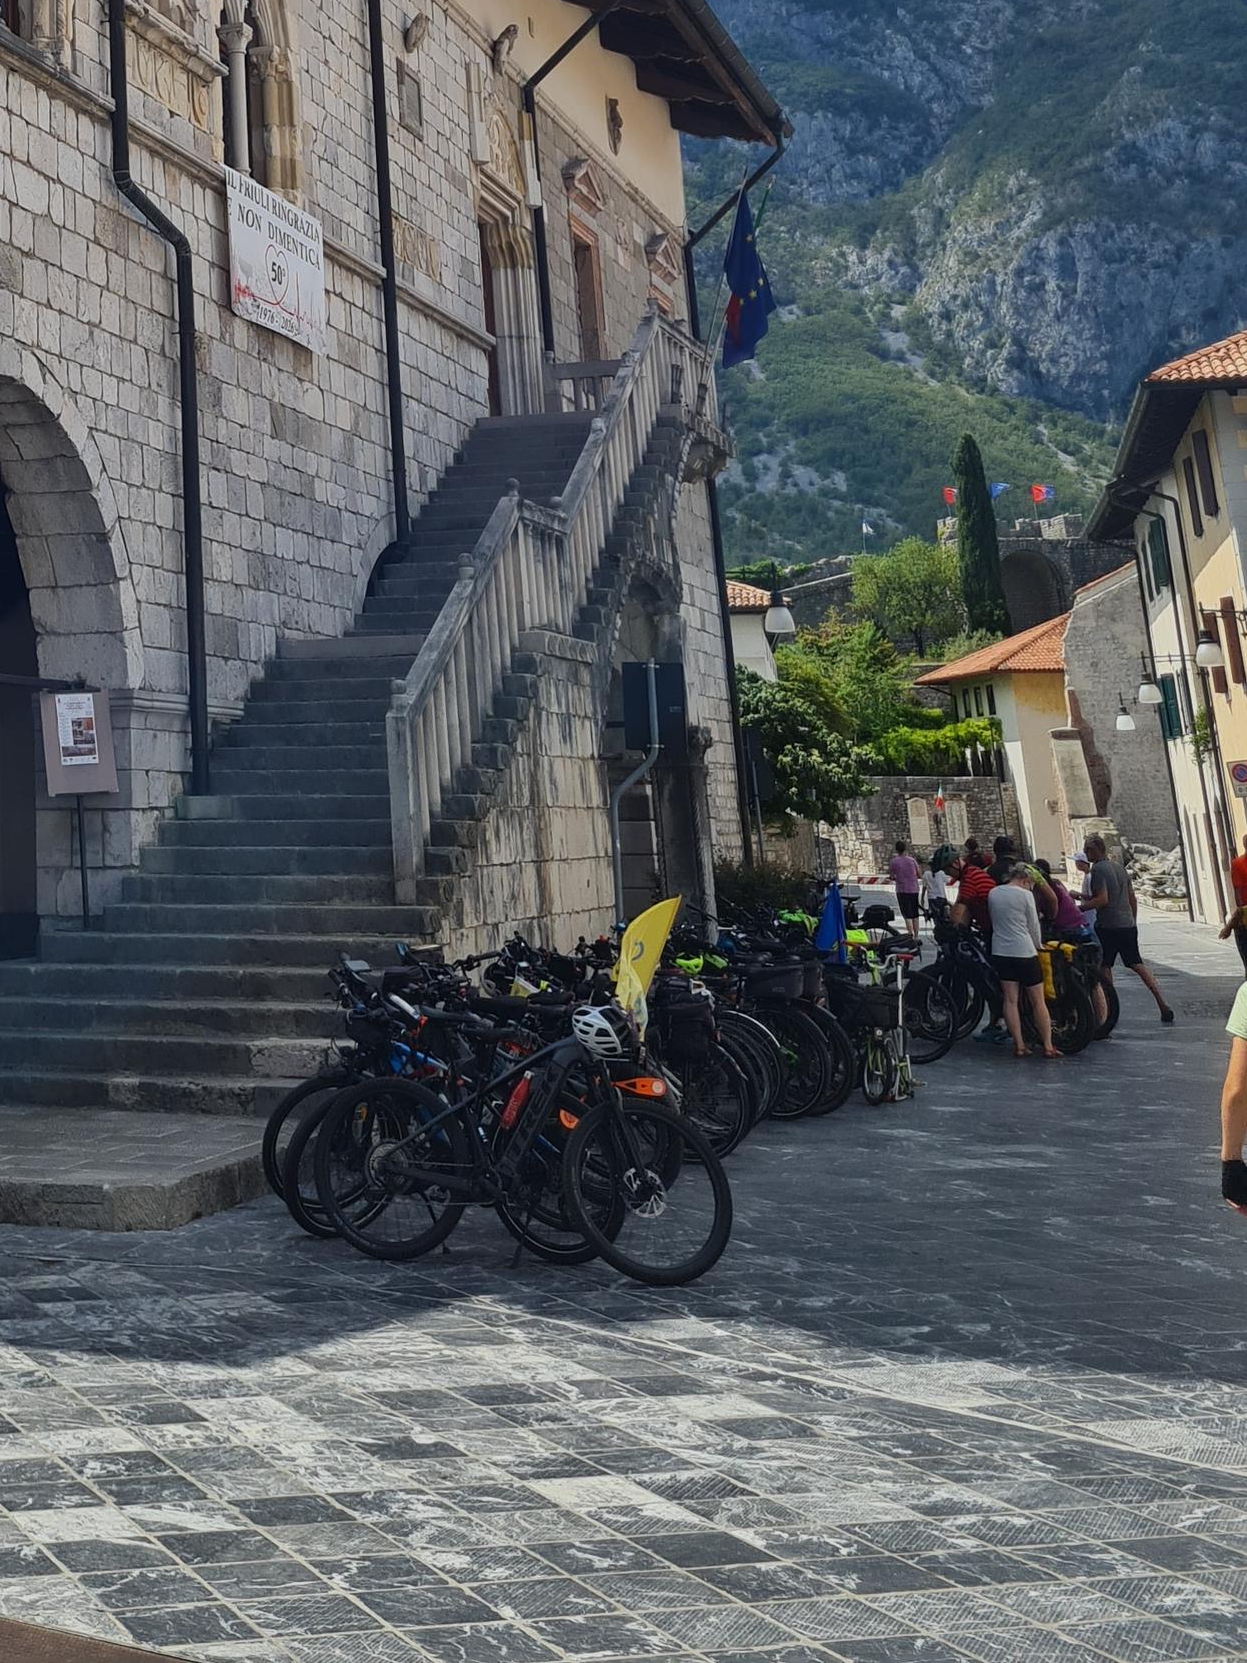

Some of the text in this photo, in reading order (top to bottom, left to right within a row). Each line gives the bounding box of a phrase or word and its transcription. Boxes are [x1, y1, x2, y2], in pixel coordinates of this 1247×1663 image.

[227, 169, 320, 245] IL FRIULI RINGRAZIA
[237, 202, 262, 234] NON
[268, 221, 321, 271] DIMENTICA
[259, 307, 274, 324] 1976
